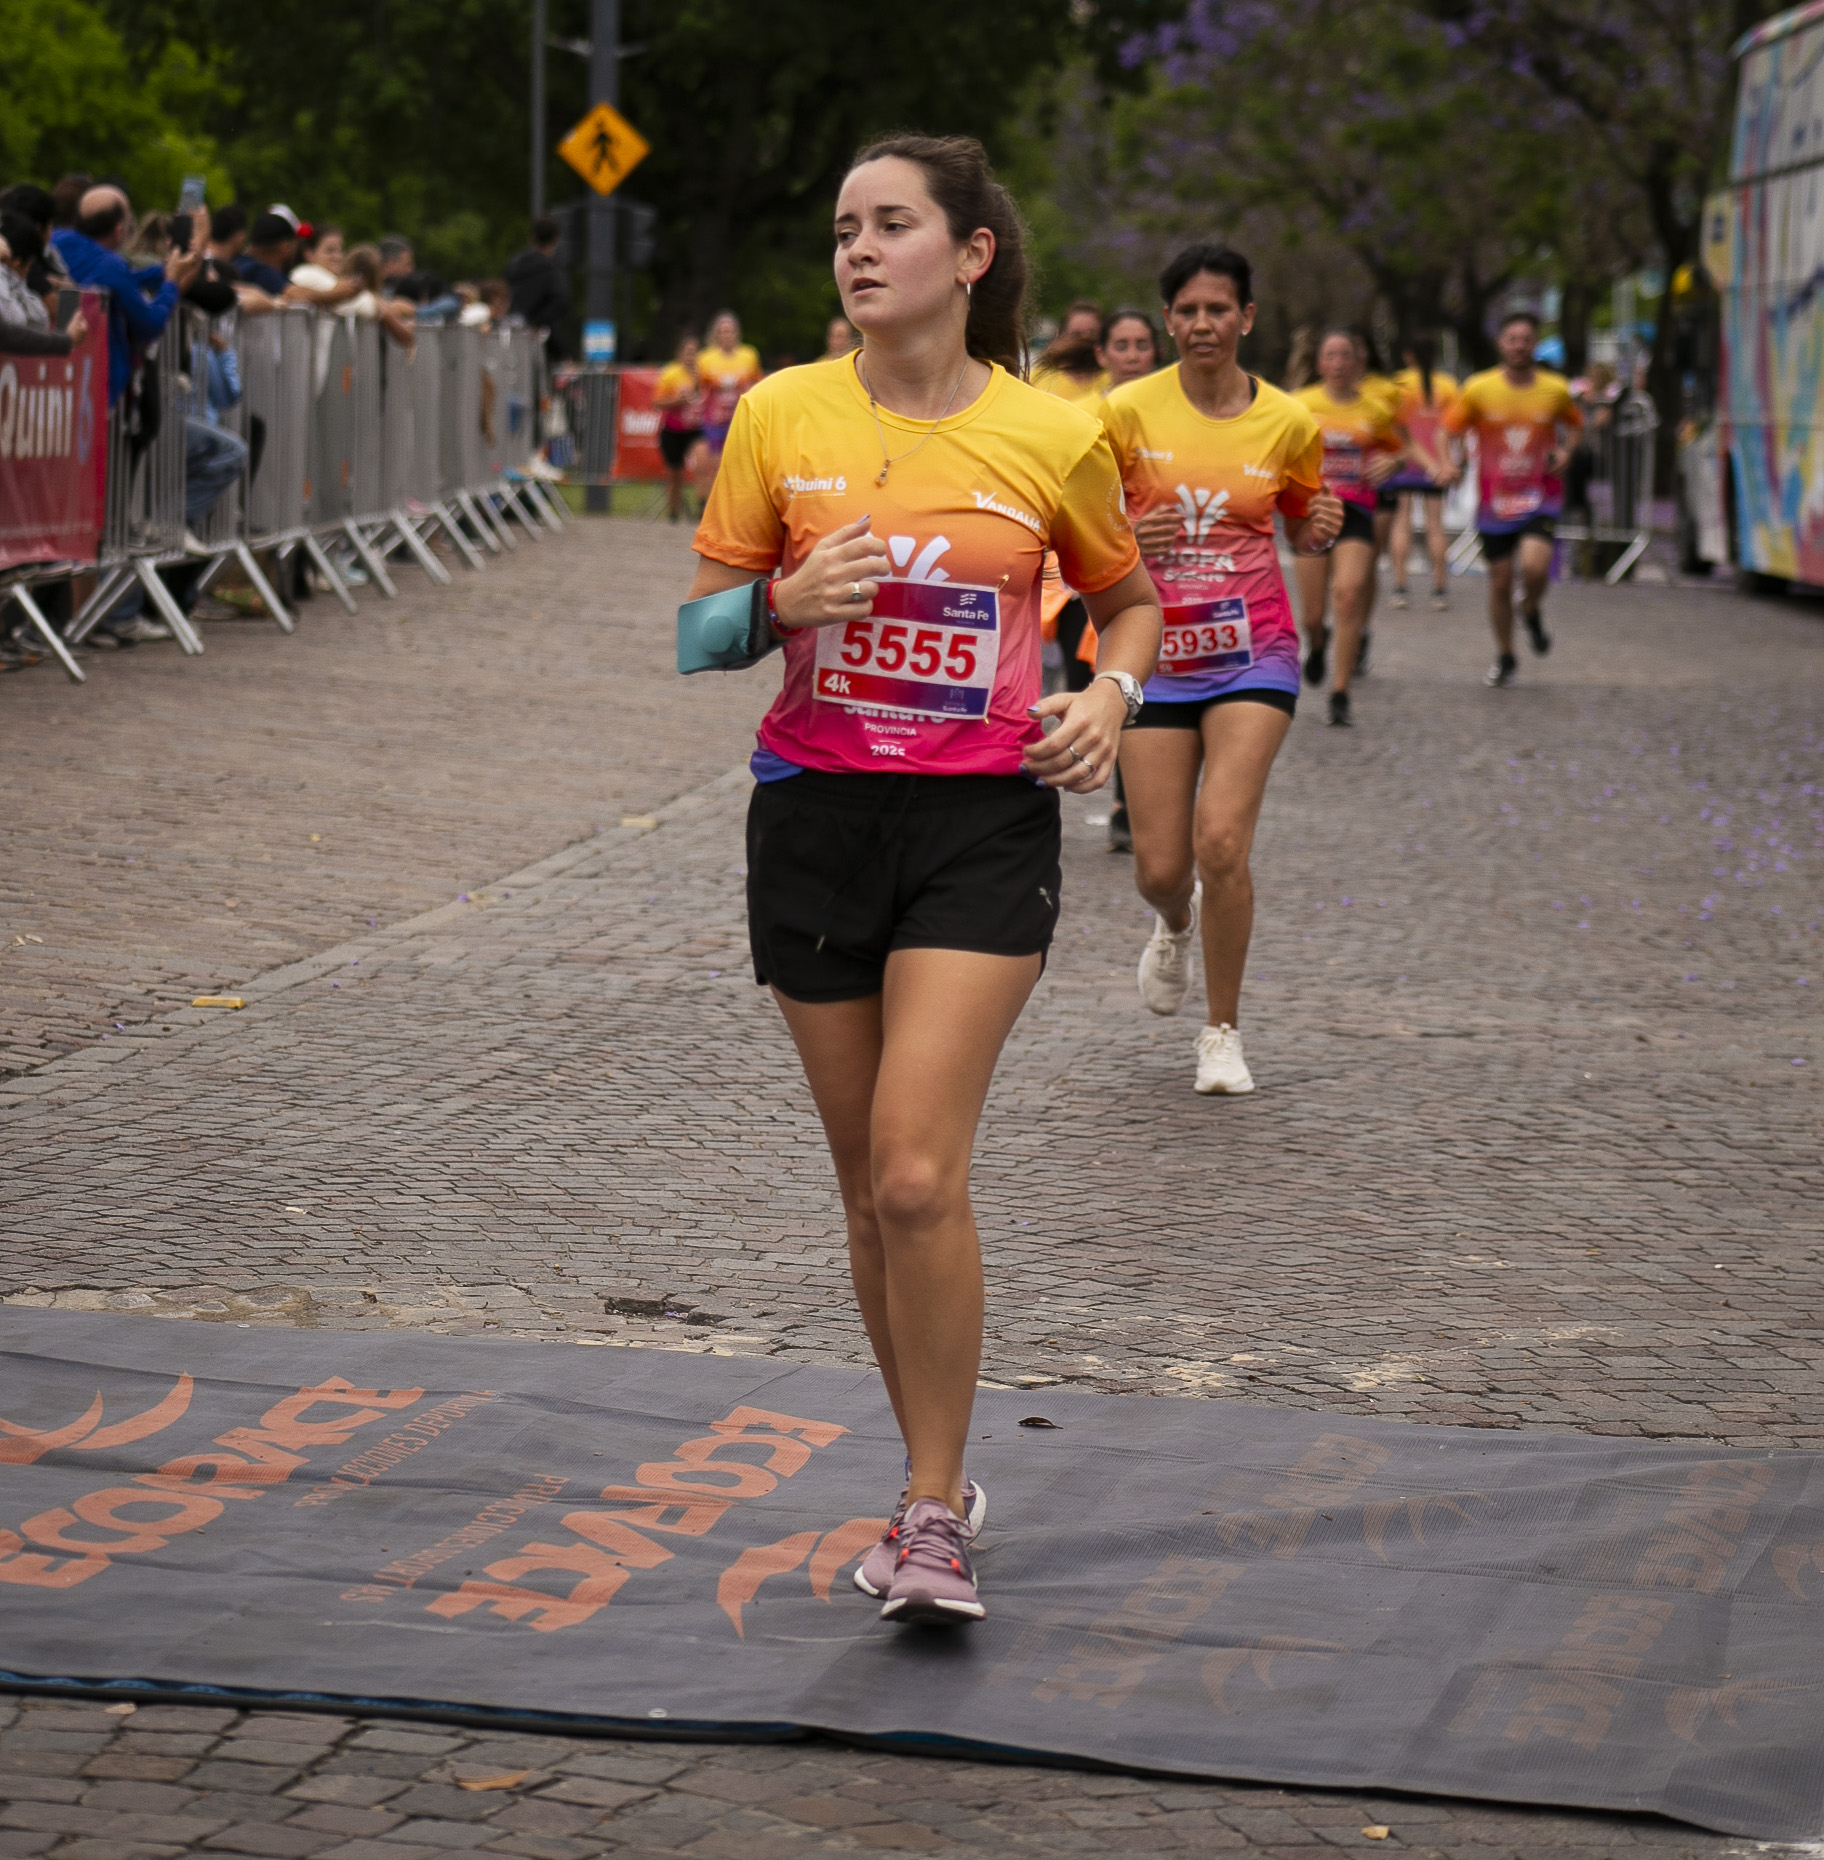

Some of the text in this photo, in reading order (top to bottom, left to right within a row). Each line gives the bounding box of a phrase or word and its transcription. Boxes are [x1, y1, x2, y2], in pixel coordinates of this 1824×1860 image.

[0, 361, 75, 460] Quini
[835, 476, 847, 491] 6
[942, 606, 990, 621] Santa Fe
[840, 621, 978, 682] 5555
[1162, 625, 1239, 658] 5933
[824, 673, 851, 694] 4k
[864, 722, 917, 736] PROVINCIA
[425, 1405, 852, 1633] ECORACE
